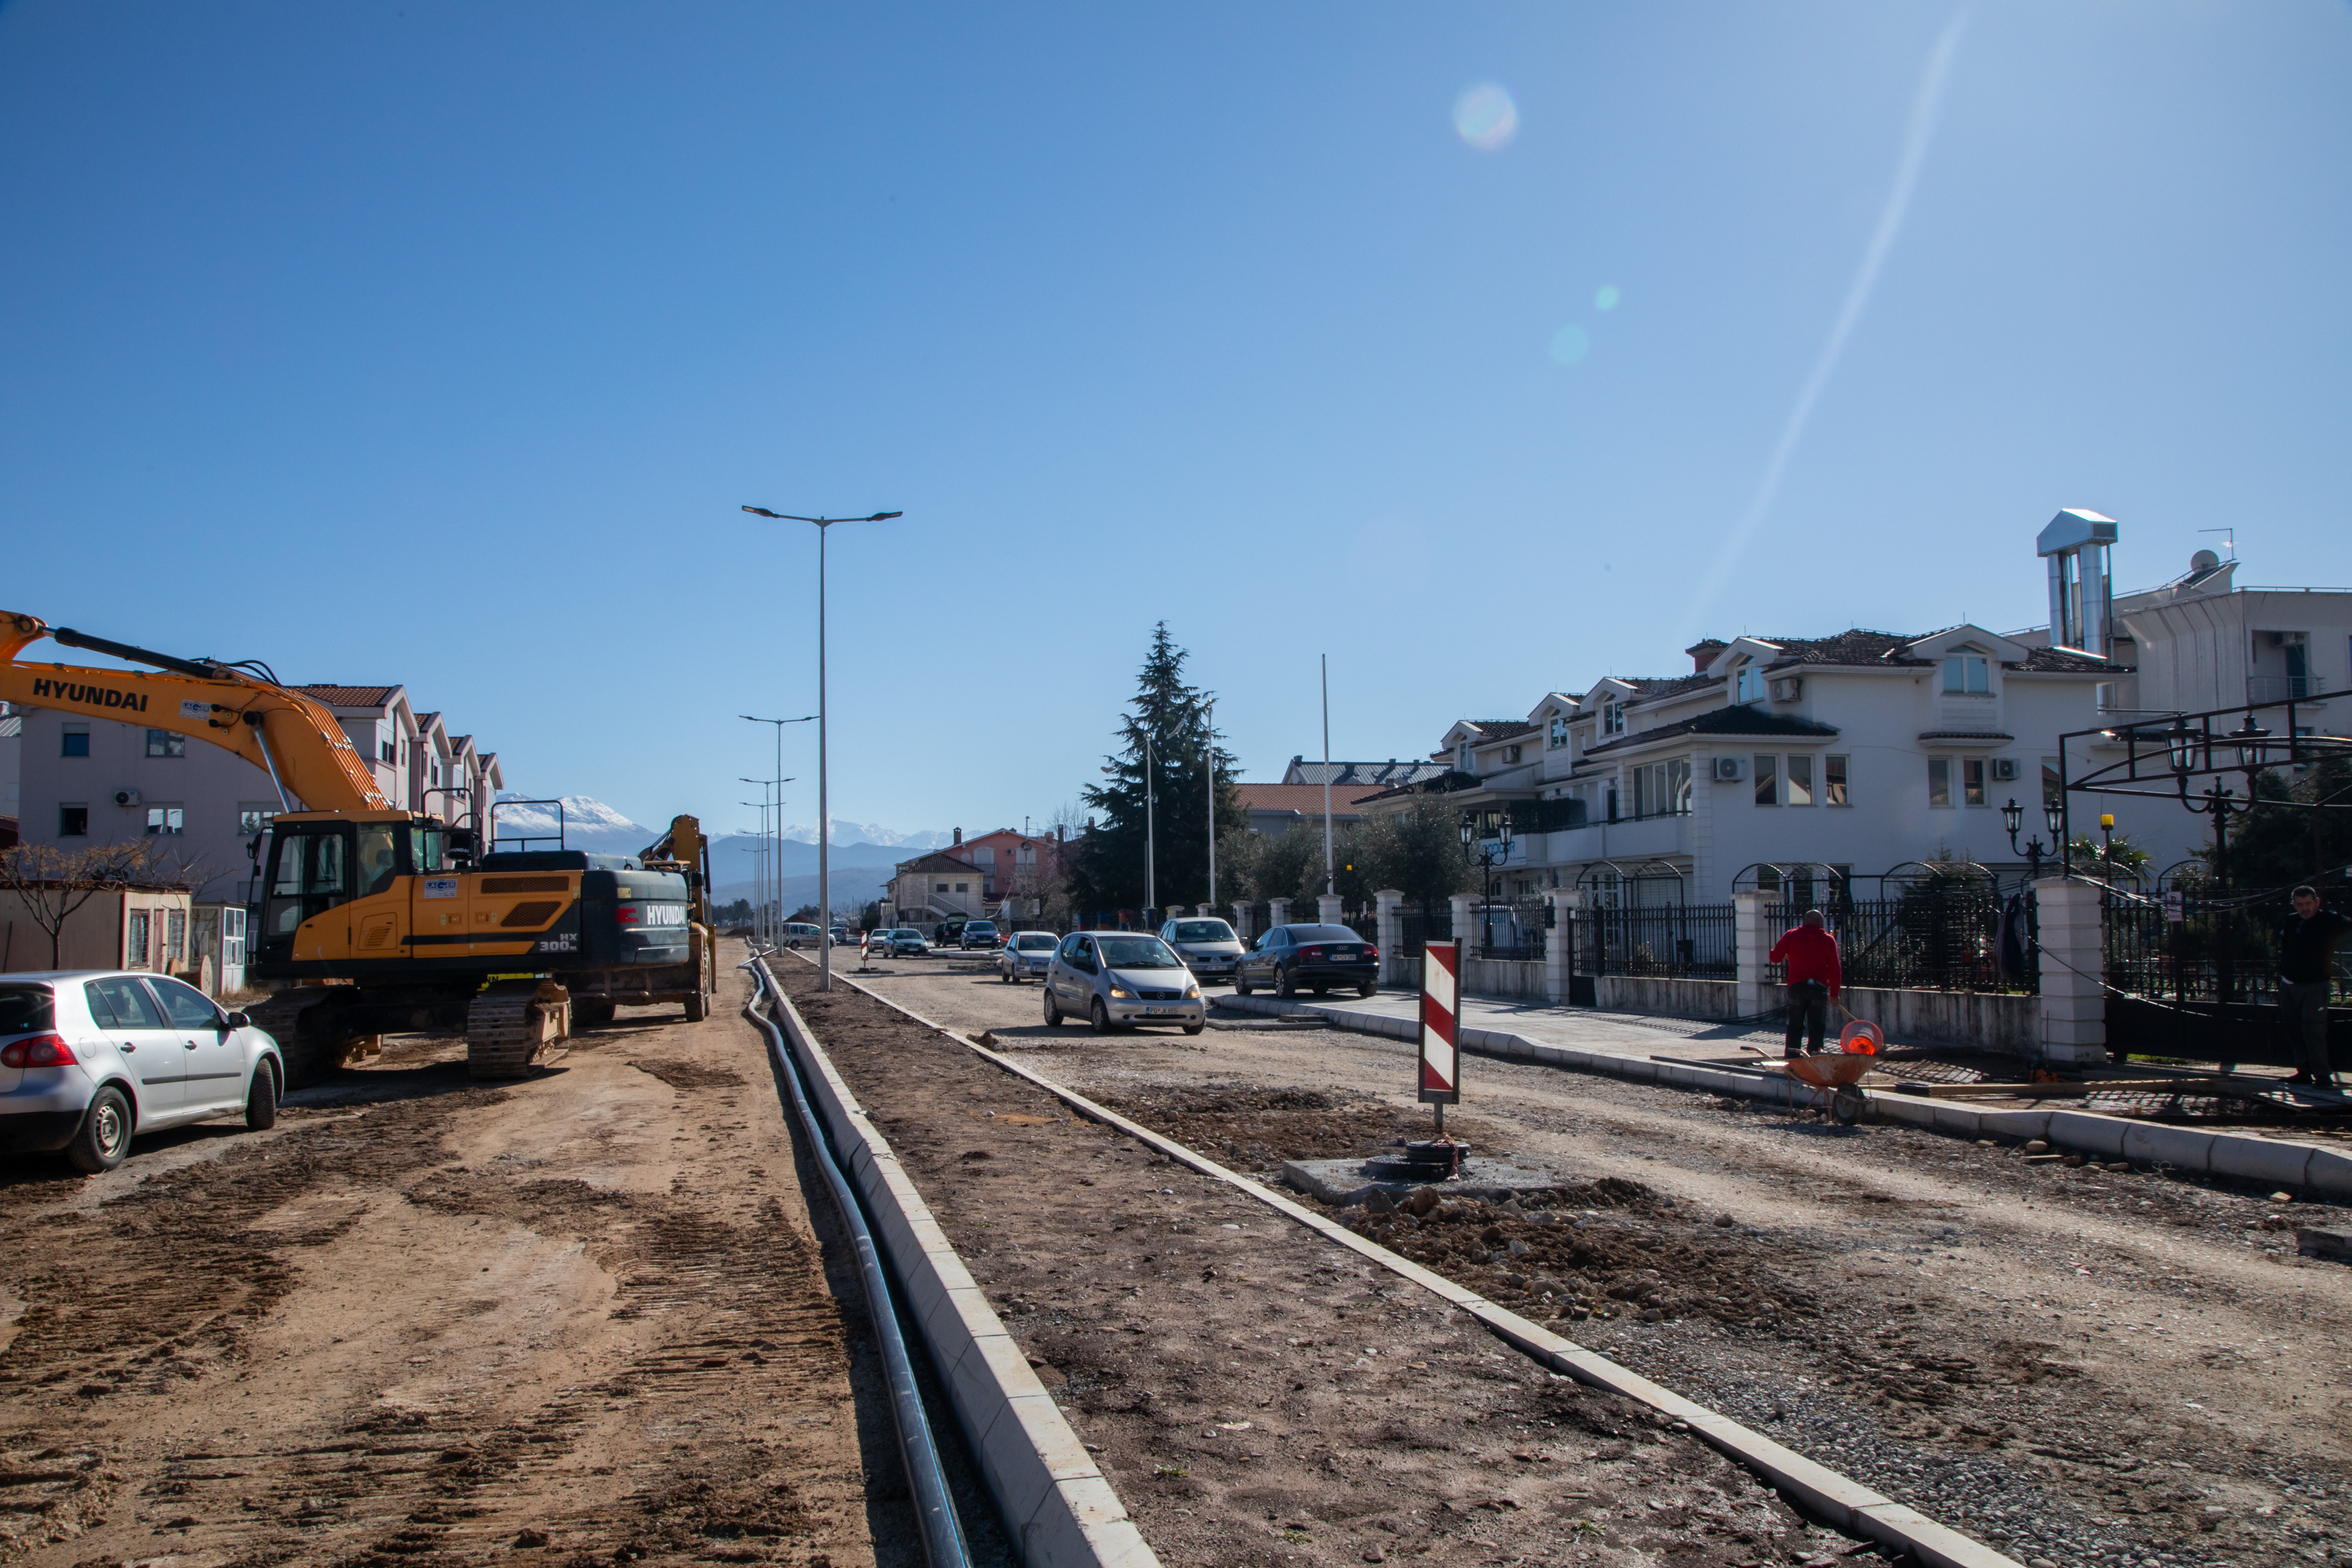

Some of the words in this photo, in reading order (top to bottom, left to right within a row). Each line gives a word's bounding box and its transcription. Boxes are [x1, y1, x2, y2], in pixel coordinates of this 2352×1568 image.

[33, 678, 148, 713] HYUNDAI
[182, 702, 210, 713] LAGER
[426, 880, 456, 891] LAGER
[646, 905, 686, 925] HYUNDAI
